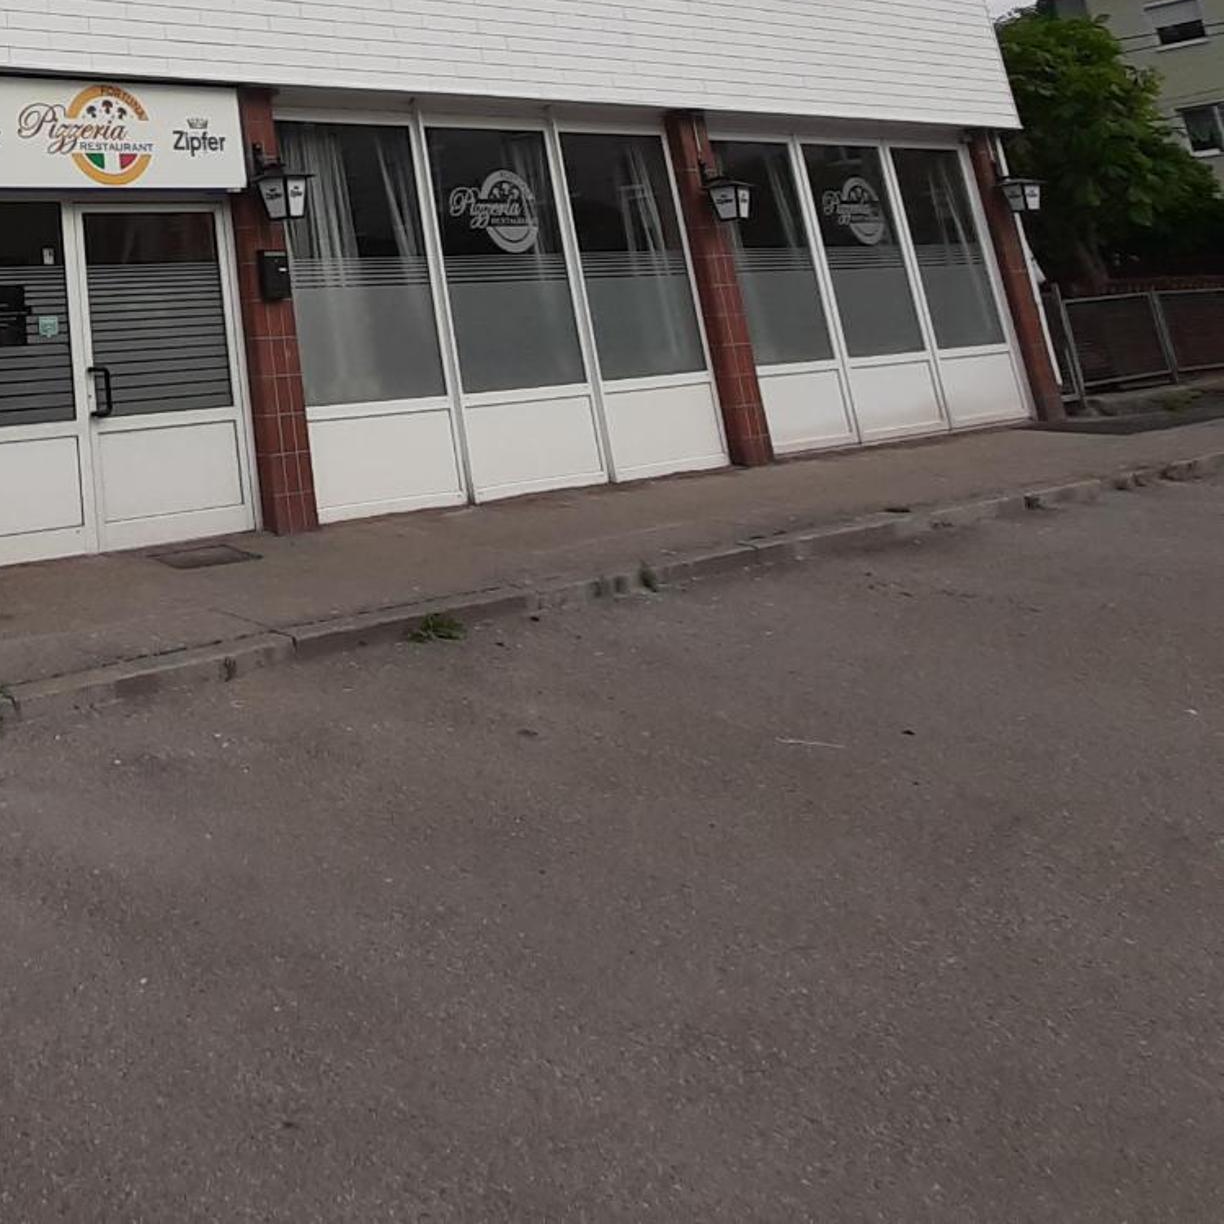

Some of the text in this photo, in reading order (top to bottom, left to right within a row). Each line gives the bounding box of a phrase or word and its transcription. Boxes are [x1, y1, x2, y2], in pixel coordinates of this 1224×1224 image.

[18, 102, 127, 154] Pizzeria
[172, 130, 225, 157] Zipfer
[79, 142, 153, 152] RESTAURANT
[449, 187, 523, 229] Pizzeria
